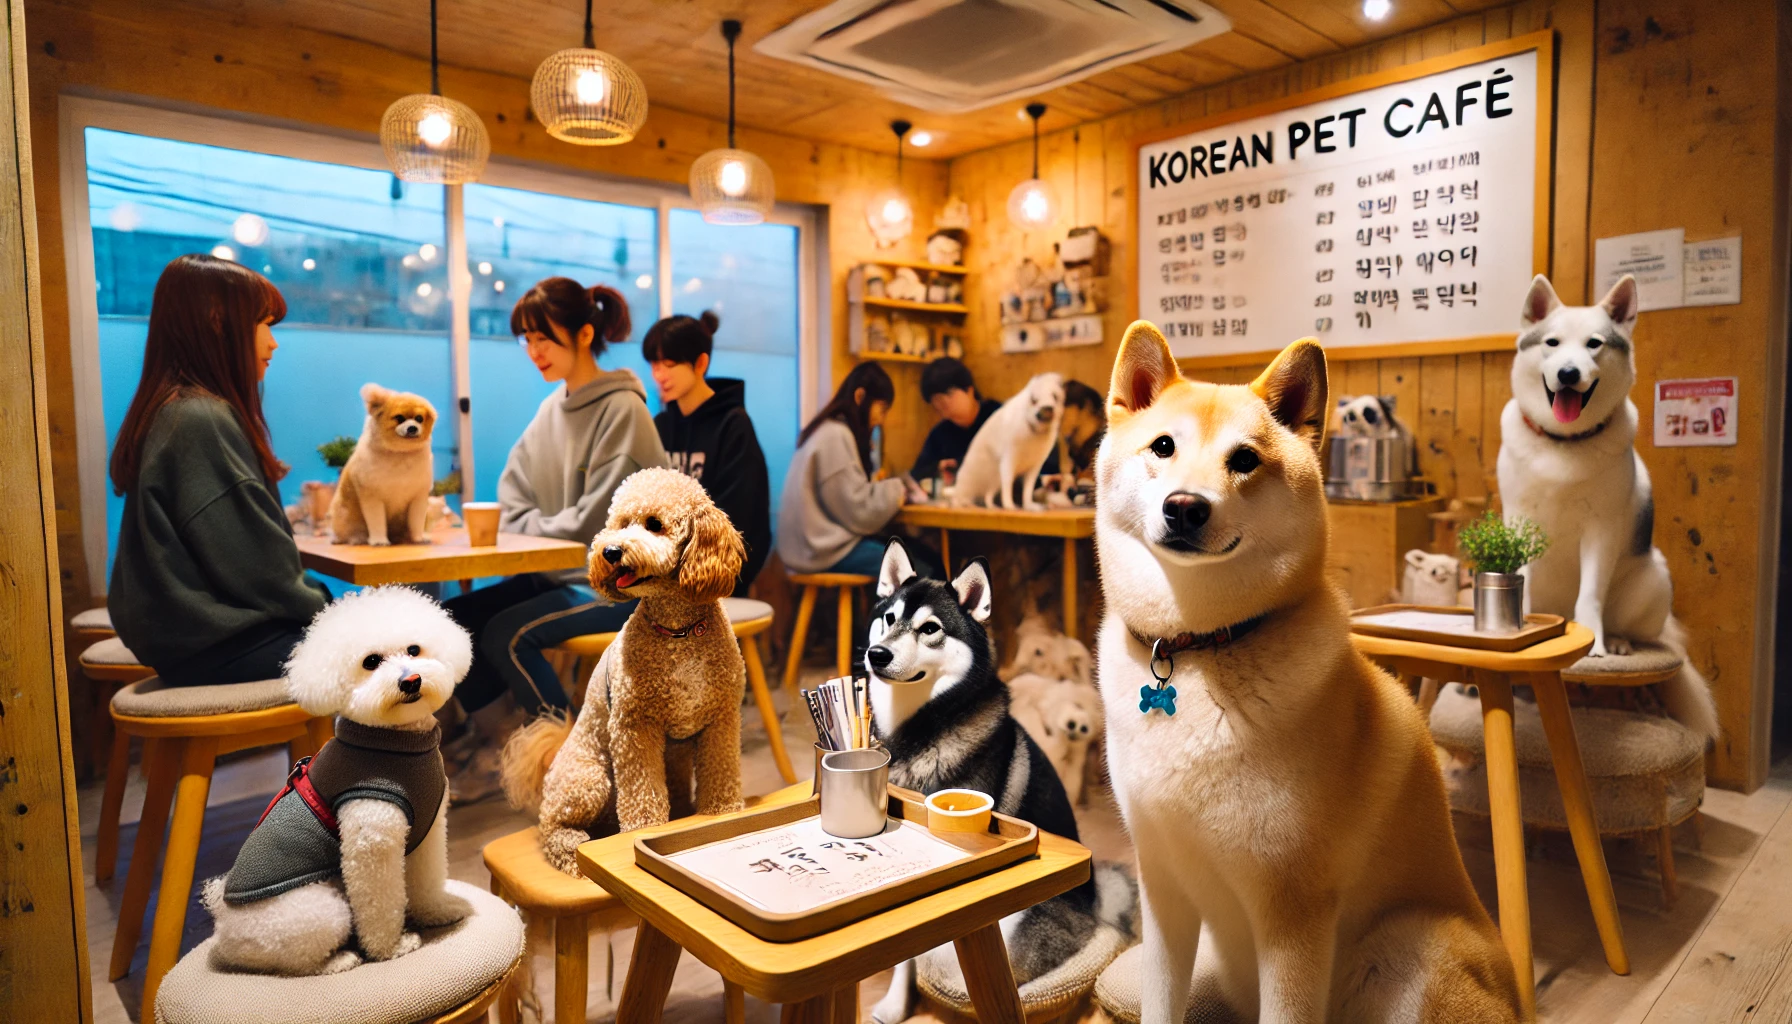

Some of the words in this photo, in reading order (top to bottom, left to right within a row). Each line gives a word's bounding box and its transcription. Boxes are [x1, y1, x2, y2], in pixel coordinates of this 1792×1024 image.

[1149, 131, 1273, 188] KOREAN
[1288, 108, 1366, 160] PET
[1384, 67, 1514, 138] CAFÉ
